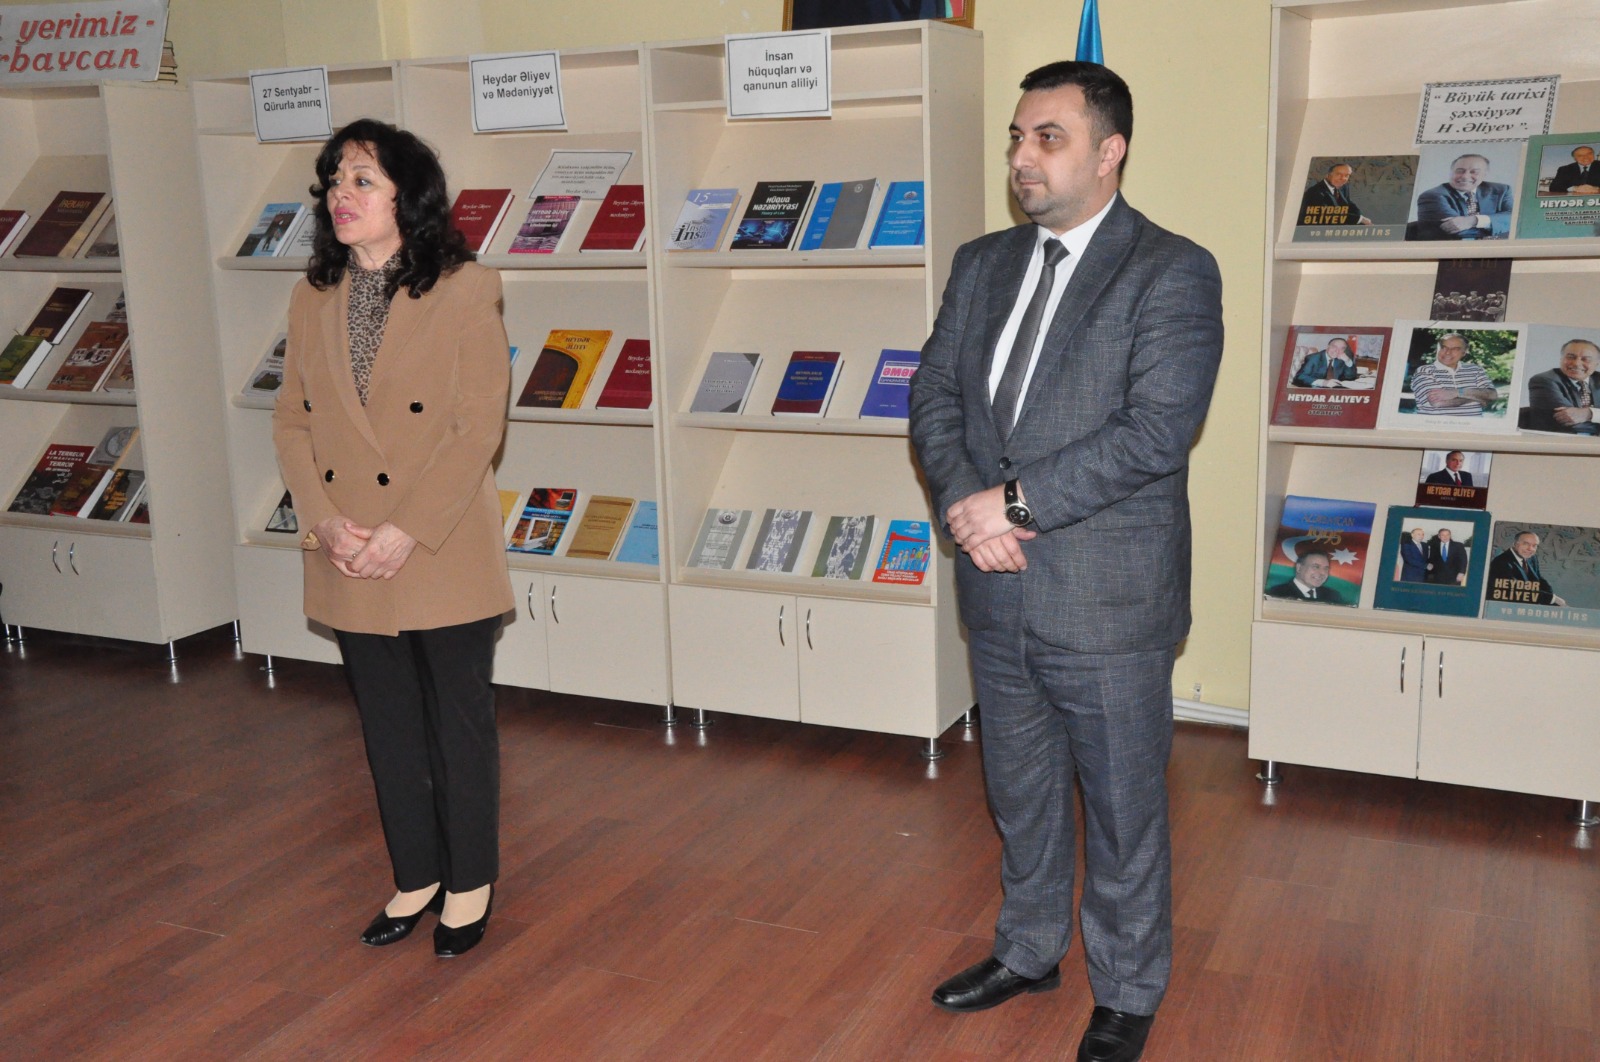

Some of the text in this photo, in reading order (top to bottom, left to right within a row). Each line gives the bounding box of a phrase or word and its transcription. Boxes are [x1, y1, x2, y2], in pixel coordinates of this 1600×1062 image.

[15, 10, 139, 45] yerimiz
[765, 49, 793, 61] İnsan
[748, 65, 812, 78] hüquqları və
[482, 70, 551, 87] Heydər Əliyev
[743, 77, 818, 93] qanunun aliliyi
[262, 88, 272, 98] 27
[274, 85, 312, 98] Sentyabr
[482, 85, 554, 100] və Mədəniyyət
[1444, 90, 1496, 105] Böyük
[1500, 87, 1548, 100] tarixi
[263, 99, 322, 112] Qürurla anırıq
[1449, 106, 1523, 121] şəxsiyyət
[752, 202, 799, 211] NƏZƏRİYYƏSİ
[766, 196, 791, 204] HÜQUQ
[1540, 199, 1584, 208] HEYDƏR
[1306, 205, 1349, 214] HEYDƏR
[1303, 214, 1347, 224] ƏLİYEV
[1287, 393, 1327, 402] HEYDAR
[1427, 485, 1475, 498] HEYDƏR ƏLİYEV
[1494, 578, 1540, 591] HEYDƏR
[1493, 589, 1540, 602] ƏLİYEV
